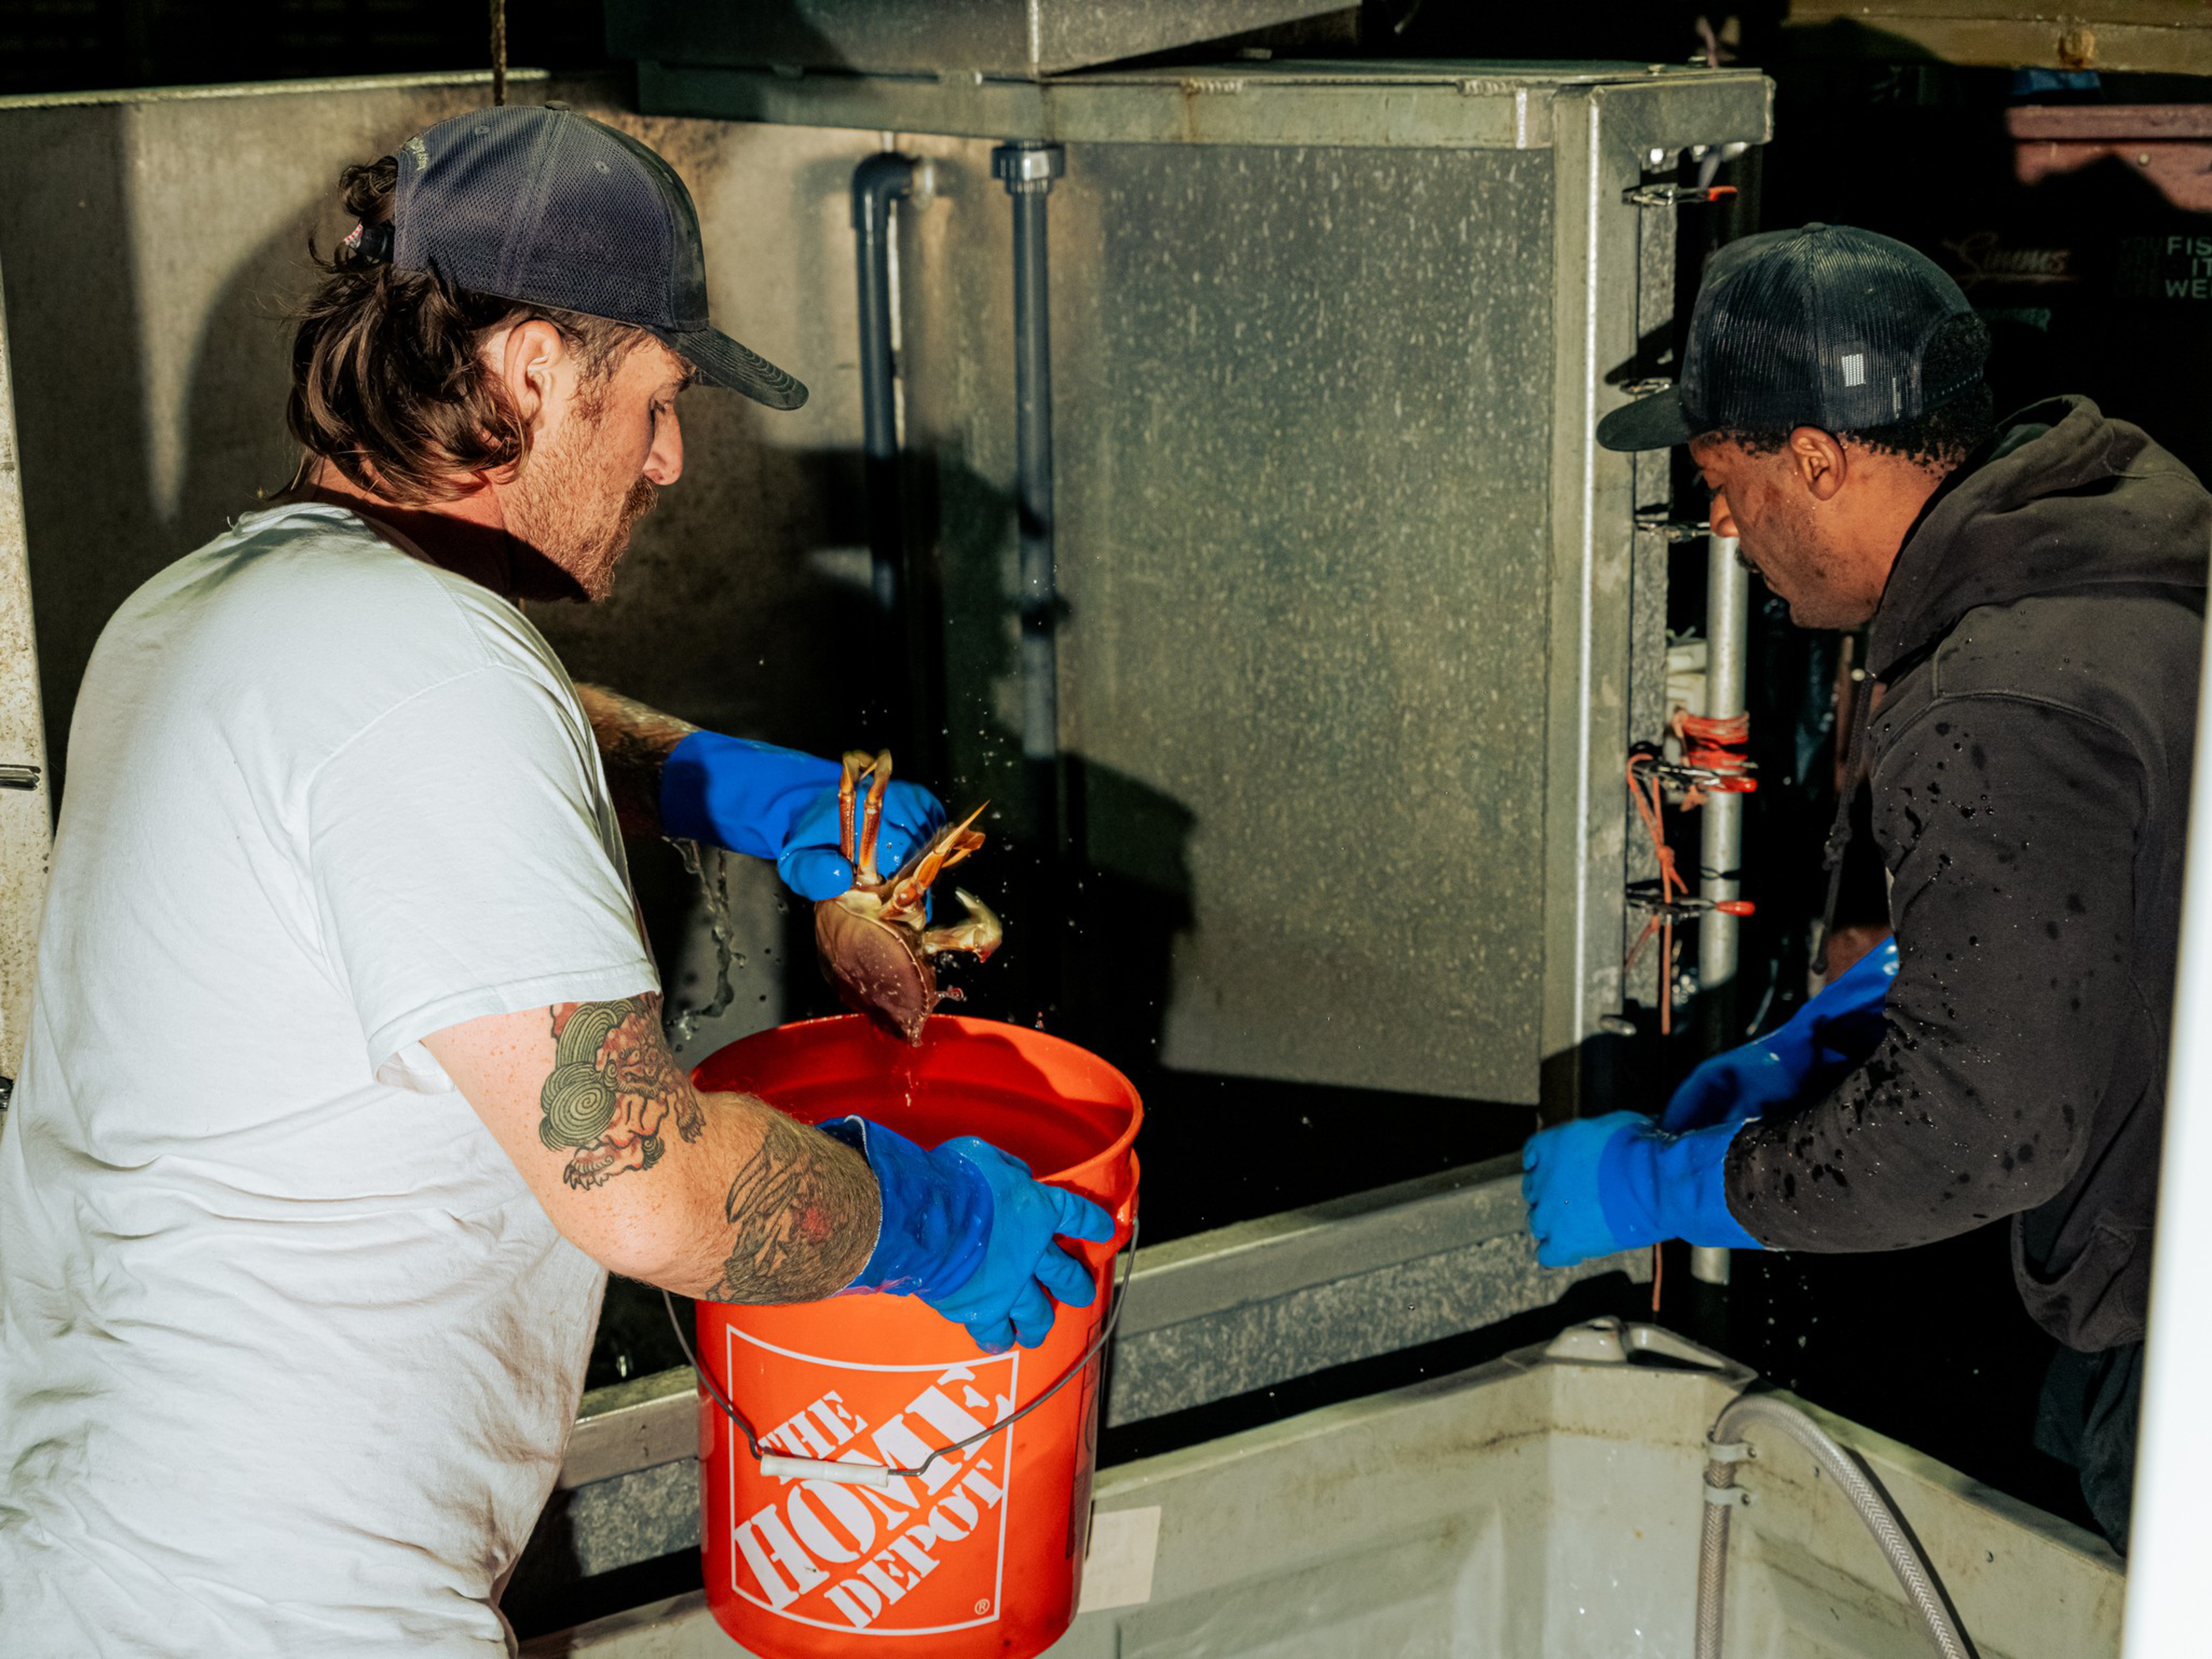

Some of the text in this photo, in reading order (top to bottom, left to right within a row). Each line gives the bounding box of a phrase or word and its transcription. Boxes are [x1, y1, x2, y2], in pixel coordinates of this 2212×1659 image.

[2164, 279, 2212, 300] WE
[2192, 257, 2212, 277] IT
[758, 1389, 867, 1485] THE
[734, 1366, 1012, 1612] HOME
[823, 1458, 1004, 1629] DEPOT
